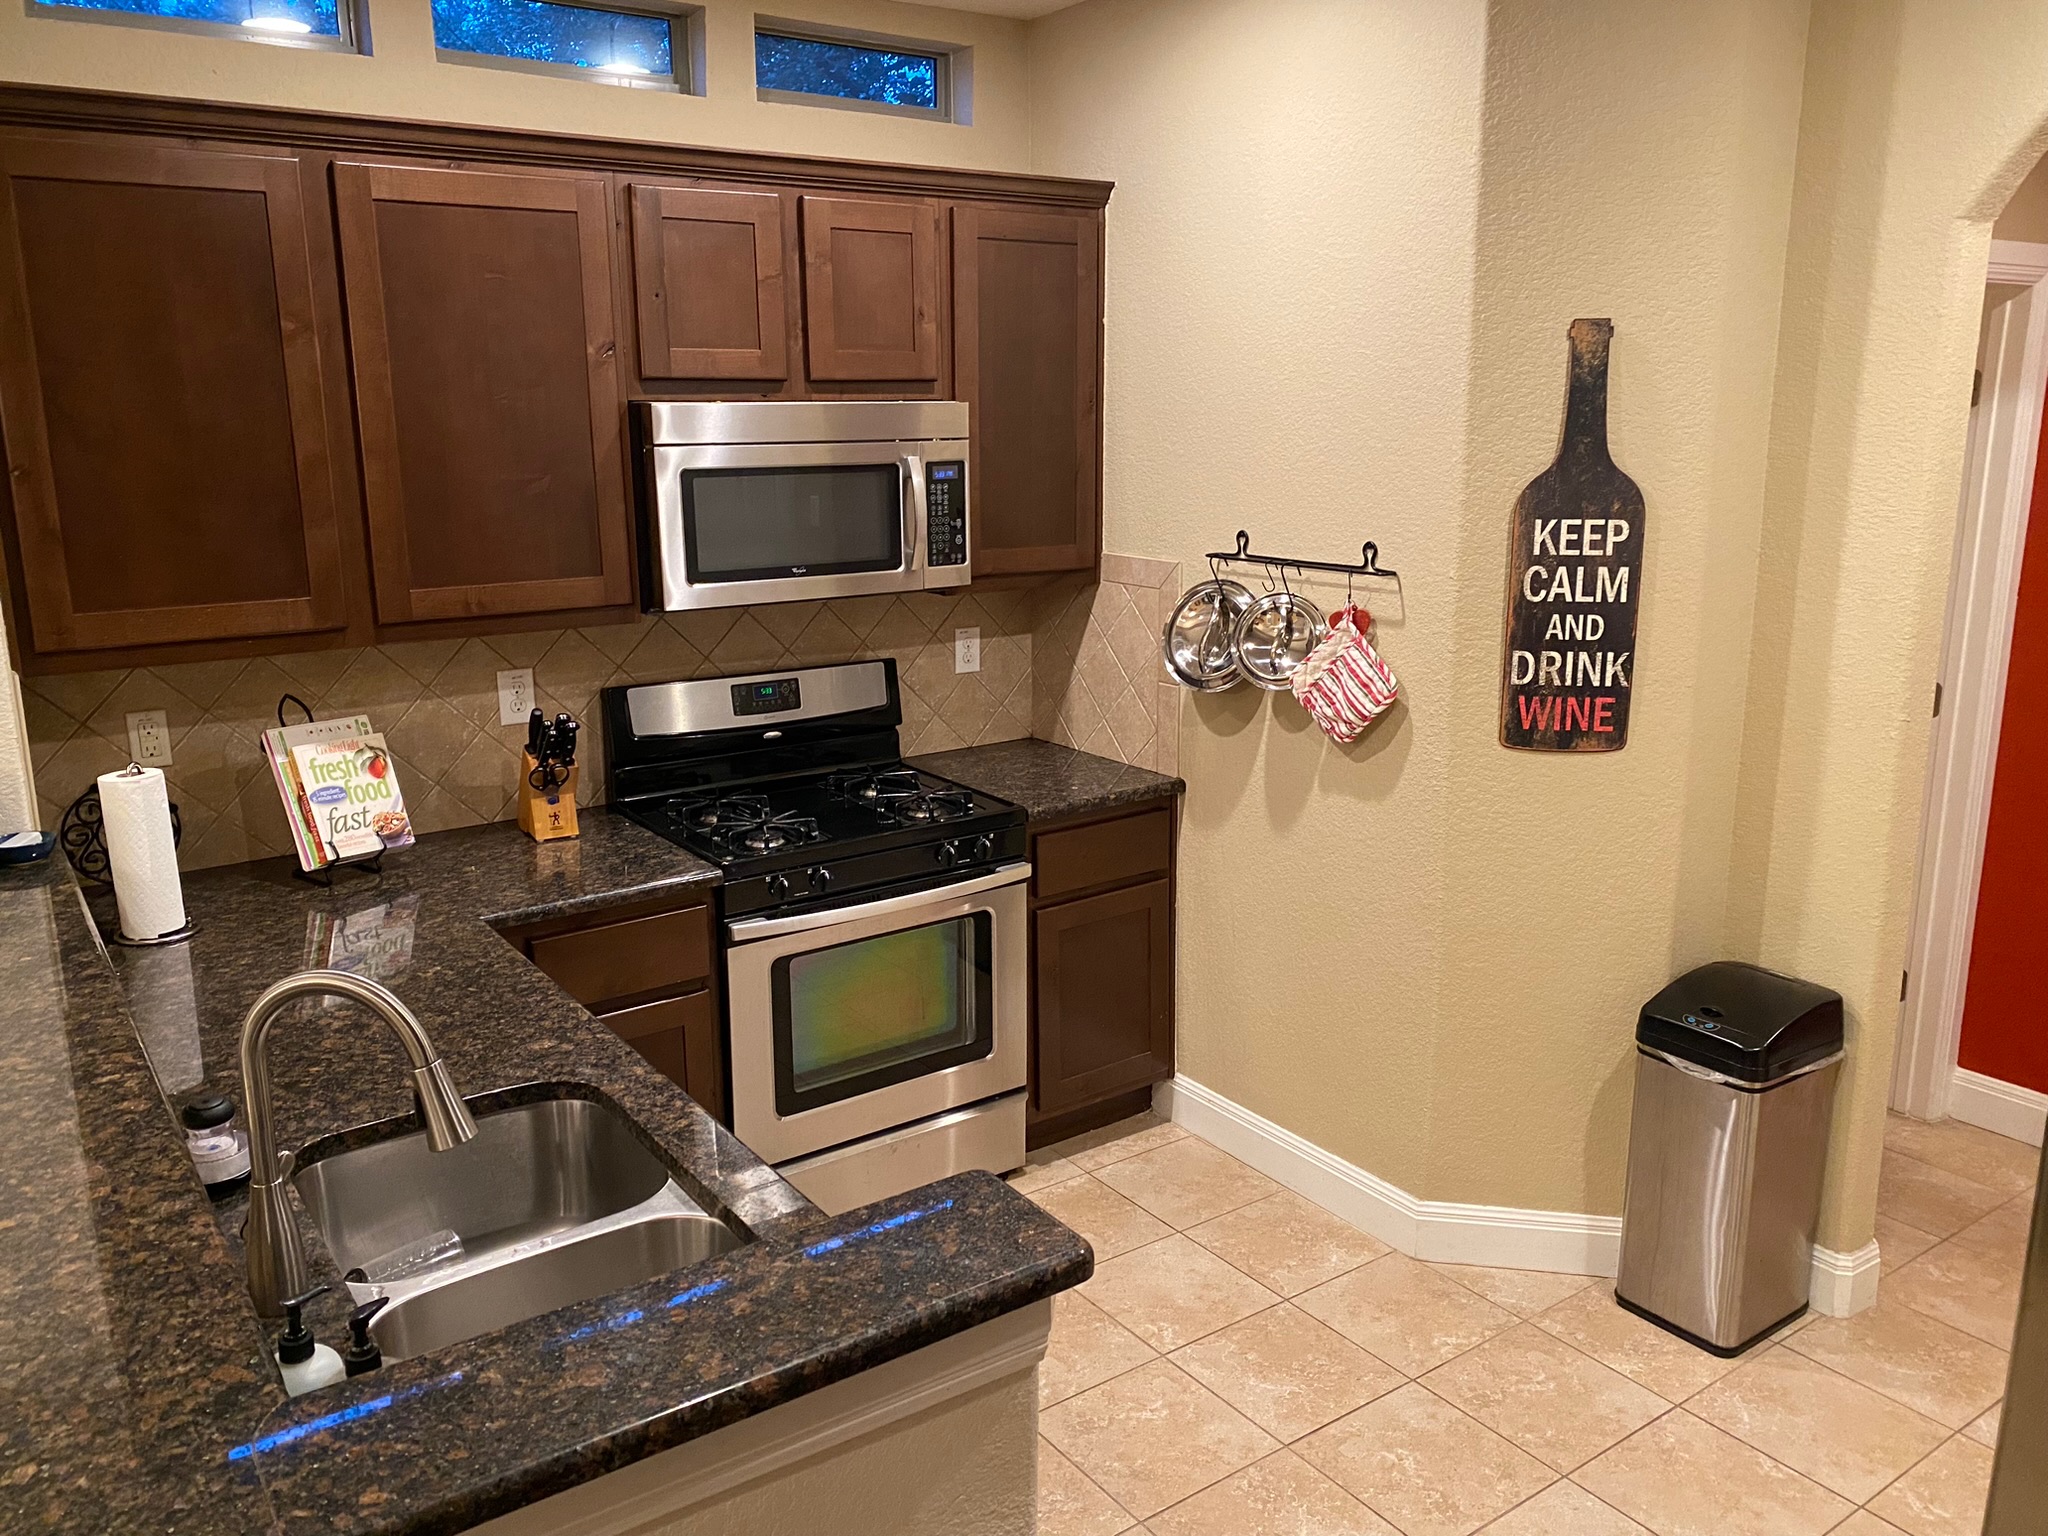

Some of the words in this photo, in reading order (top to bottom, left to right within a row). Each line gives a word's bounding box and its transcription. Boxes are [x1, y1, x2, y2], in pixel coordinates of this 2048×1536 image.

[1532, 518, 1630, 556] KEEP
[1523, 565, 1630, 603] CALM
[1544, 613, 1605, 641] AND
[1510, 650, 1630, 688] DRINK
[1518, 695, 1616, 732] WINE
[309, 755, 359, 784] fresh
[344, 776, 392, 805] food
[326, 806, 371, 842] fast
